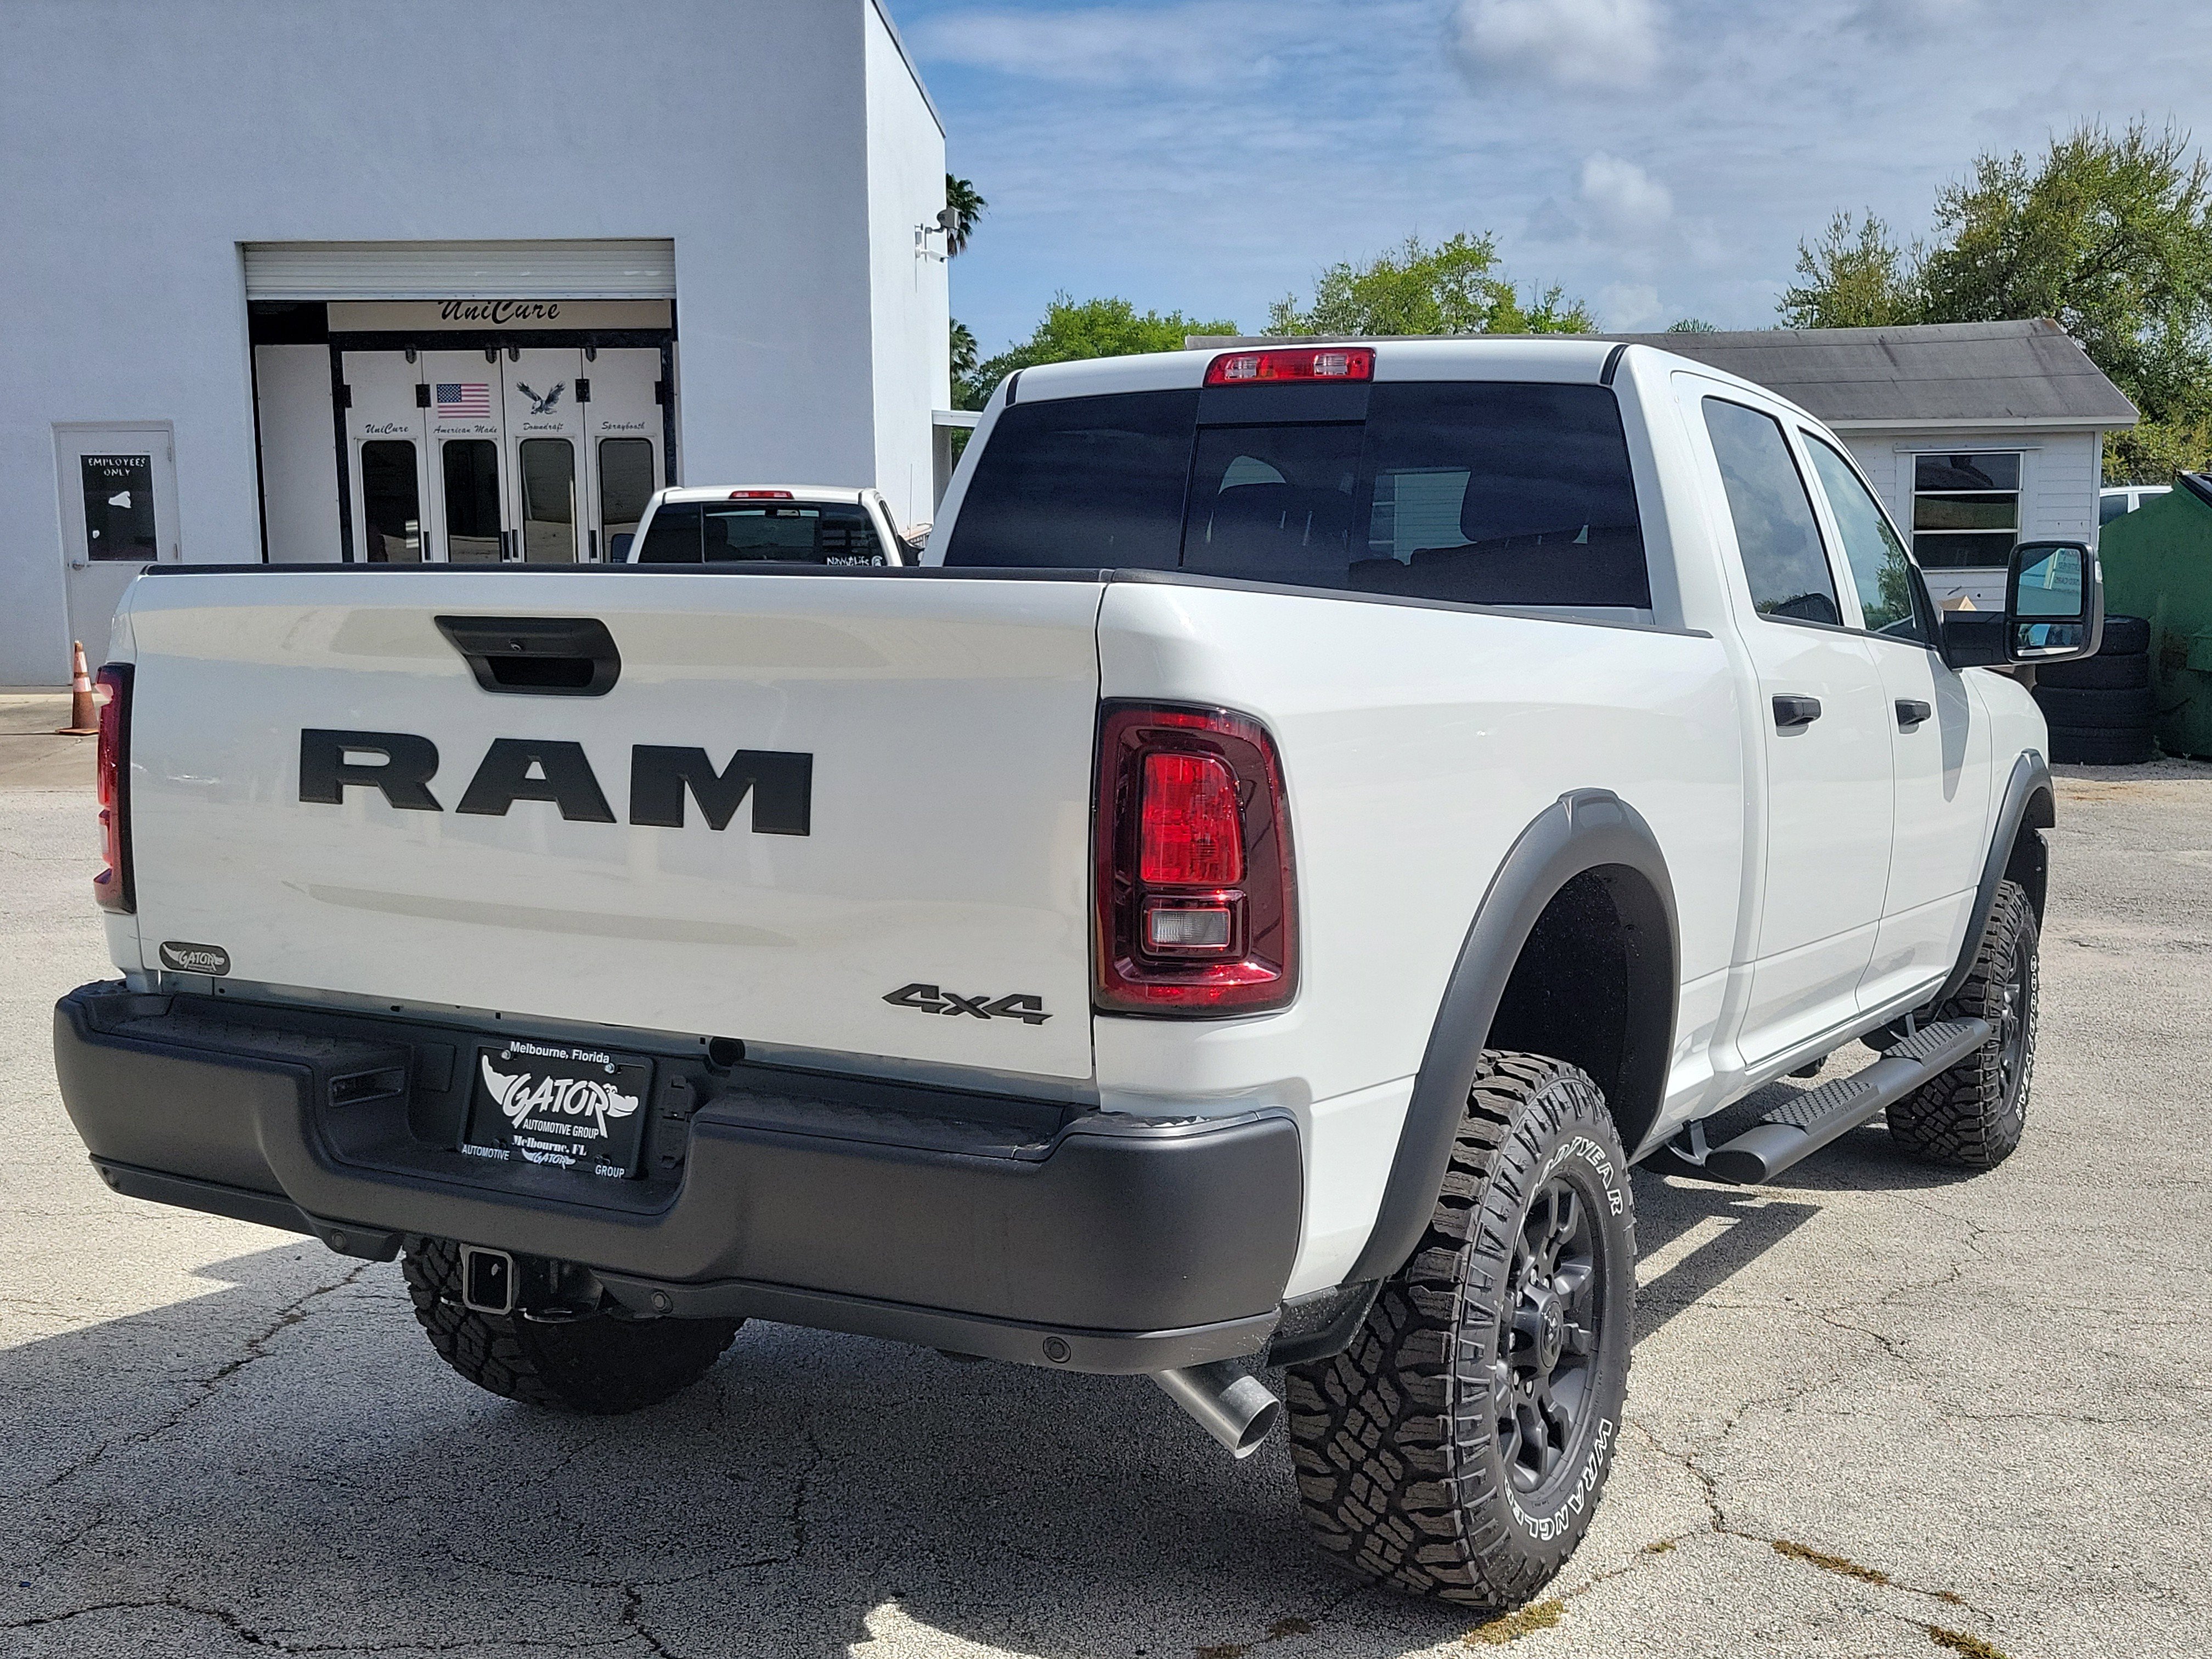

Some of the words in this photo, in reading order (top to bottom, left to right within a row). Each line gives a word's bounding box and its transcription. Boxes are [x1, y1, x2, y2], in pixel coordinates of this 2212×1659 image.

[438, 302, 560, 324] UniCure
[365, 423, 409, 434] UniCure
[523, 422, 563, 432] Downdraft
[602, 421, 645, 431] Spraybooth
[88, 458, 145, 467] EMPLOYEES
[299, 728, 813, 836] RAM
[179, 950, 217, 972] GATOR
[2016, 955, 2037, 1121] GOODYEAR
[510, 1041, 568, 1059] Melbourne,
[572, 1048, 610, 1064] Florida
[503, 1073, 608, 1138] GATOR
[522, 1118, 571, 1136] AUTOMOTIVE
[572, 1126, 599, 1139] GROUP
[461, 1144, 510, 1160] AUTOMOTIVE
[572, 1143, 587, 1156] FL
[533, 1151, 566, 1170] GATOR
[595, 1164, 625, 1178] GROUP
[1504, 1418, 1612, 1541] WRANGLER
